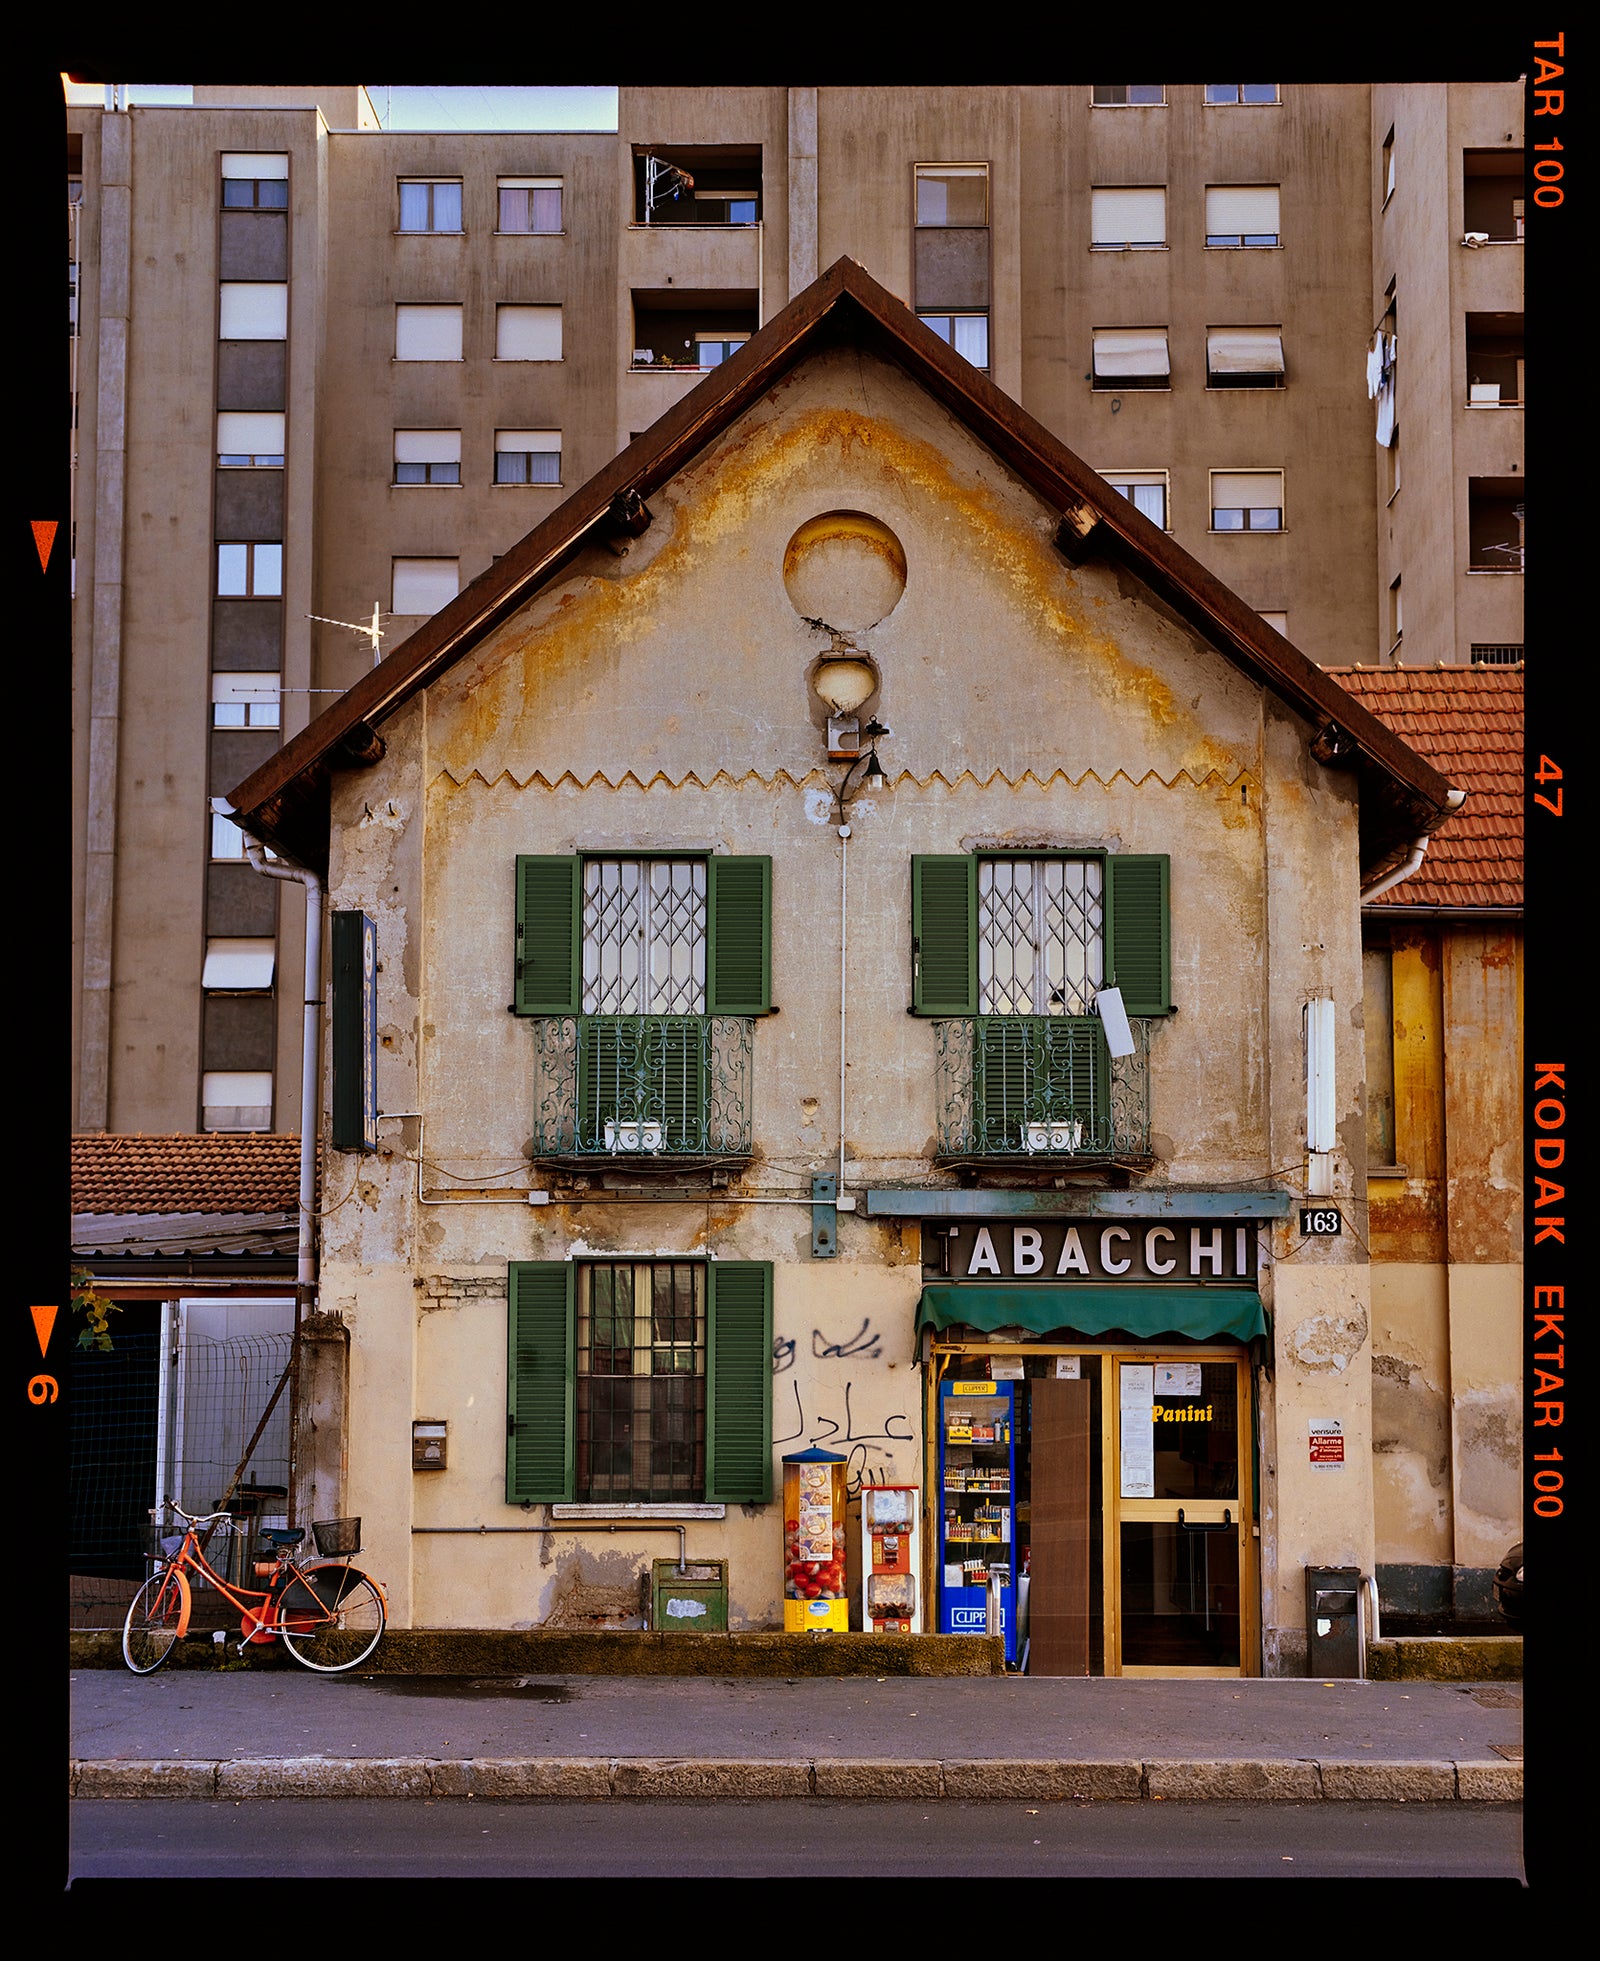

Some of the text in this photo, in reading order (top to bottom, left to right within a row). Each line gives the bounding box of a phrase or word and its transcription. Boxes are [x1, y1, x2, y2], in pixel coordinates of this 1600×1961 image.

[1304, 1211, 1338, 1233] 163
[1151, 1405, 1213, 1422] Panini
[955, 1611, 1002, 1624] CLIPP
